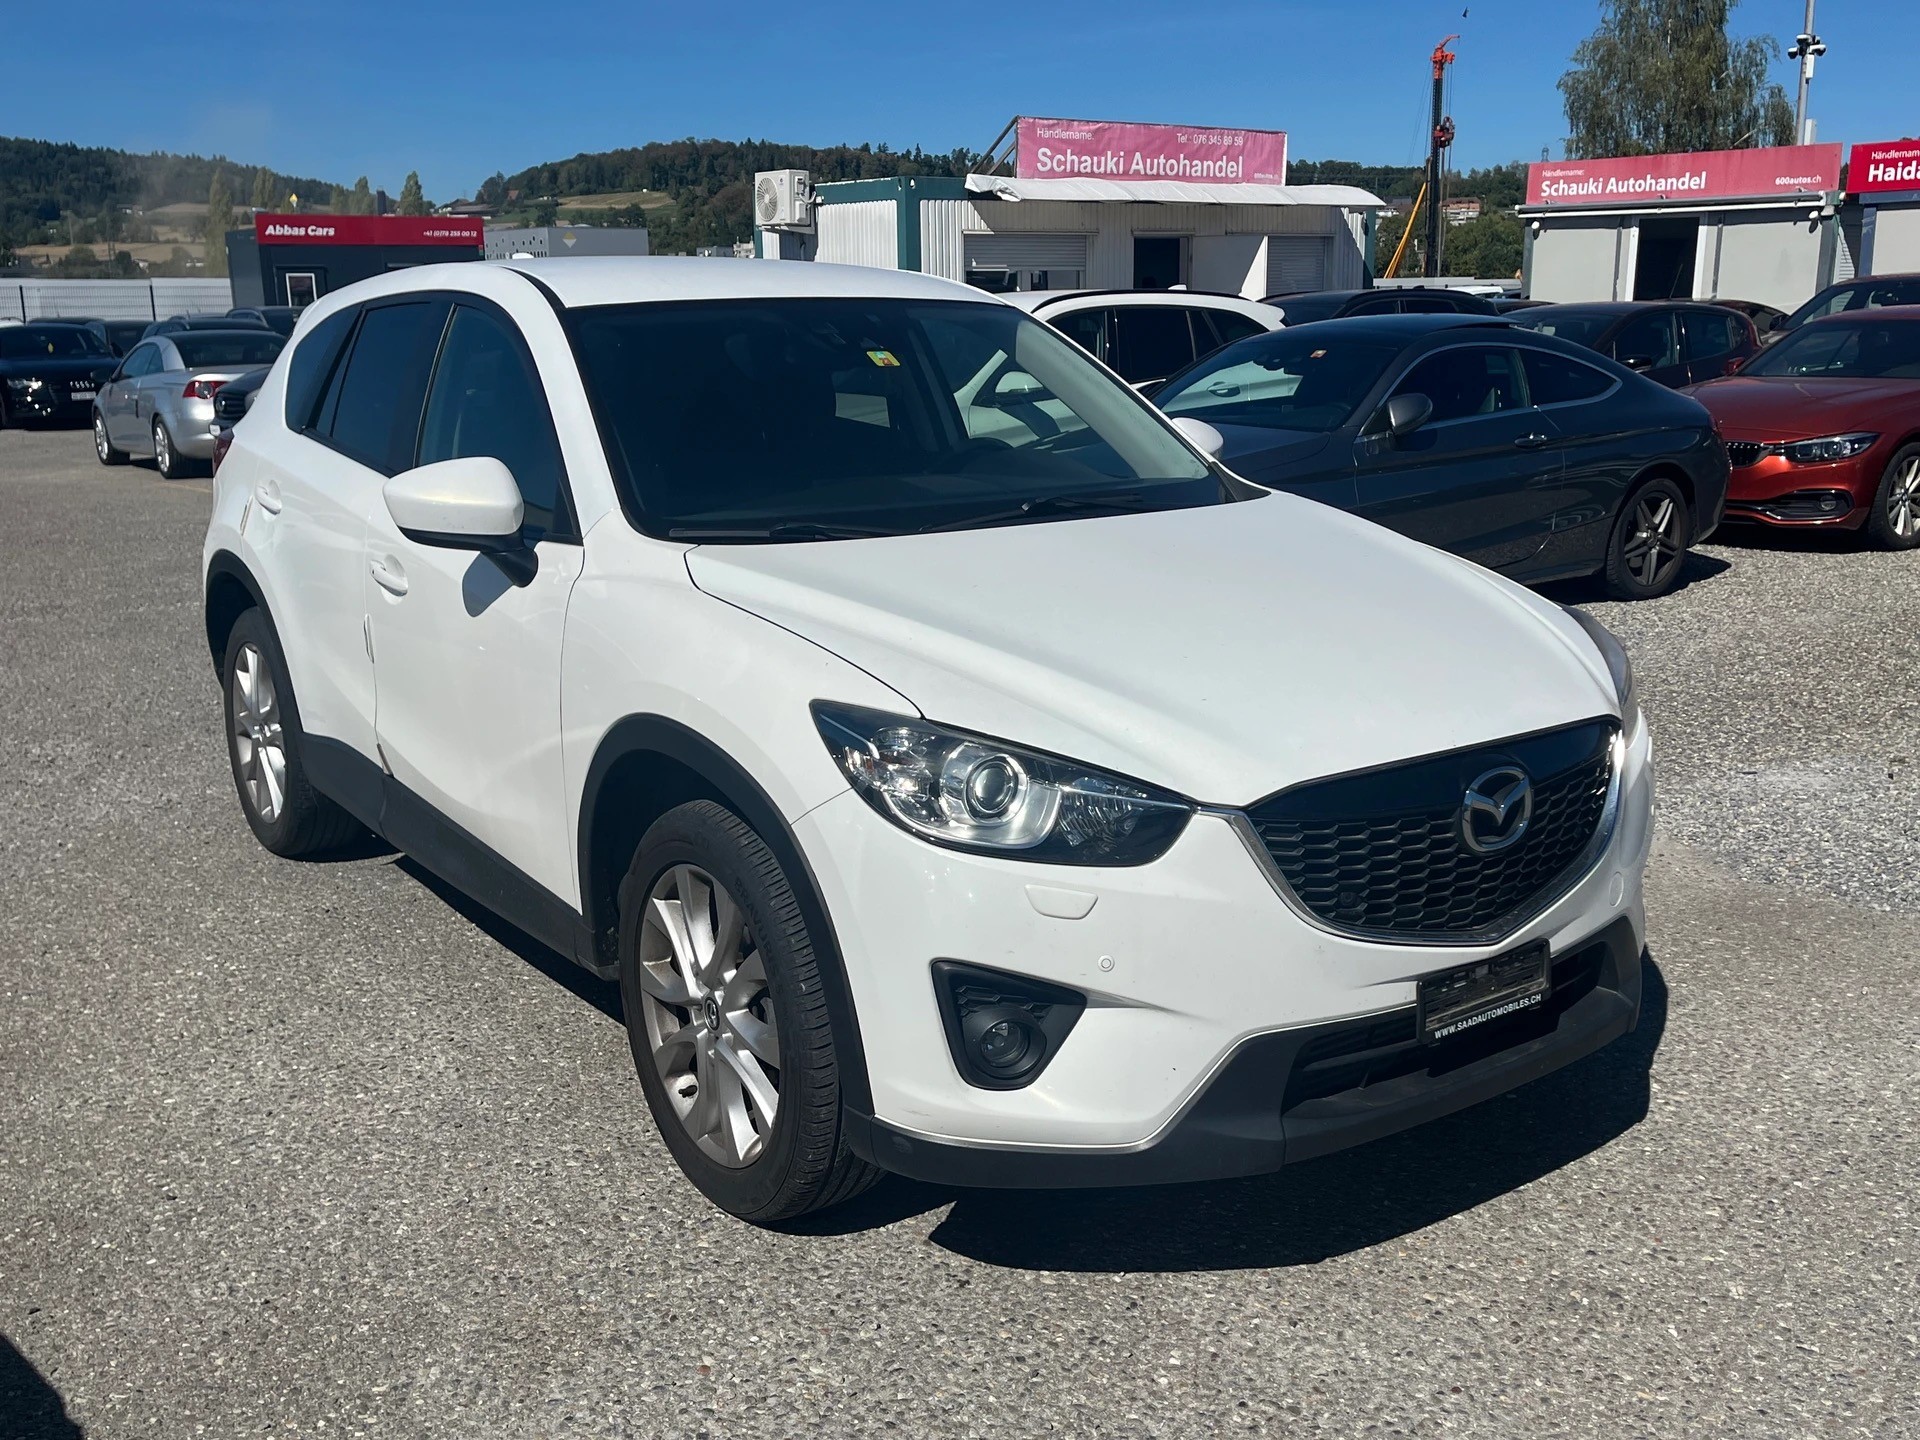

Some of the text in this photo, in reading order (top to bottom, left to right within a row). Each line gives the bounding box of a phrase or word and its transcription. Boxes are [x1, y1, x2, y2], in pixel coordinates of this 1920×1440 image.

[1193, 134, 1207, 145] 076
[1208, 135, 1222, 145] 345
[1223, 136, 1233, 146] 89
[1234, 136, 1244, 146] 59
[1871, 149, 1920, 160] Händlernam
[1037, 148, 1243, 178] Schauki Autohandel
[1541, 171, 1706, 197] Schauki Autohandel
[1775, 174, 1822, 185] 600autos.ch
[265, 224, 335, 237] Abbas Cars
[1434, 993, 1542, 1039] WWW.SAADAUTOMOBILES.CH
